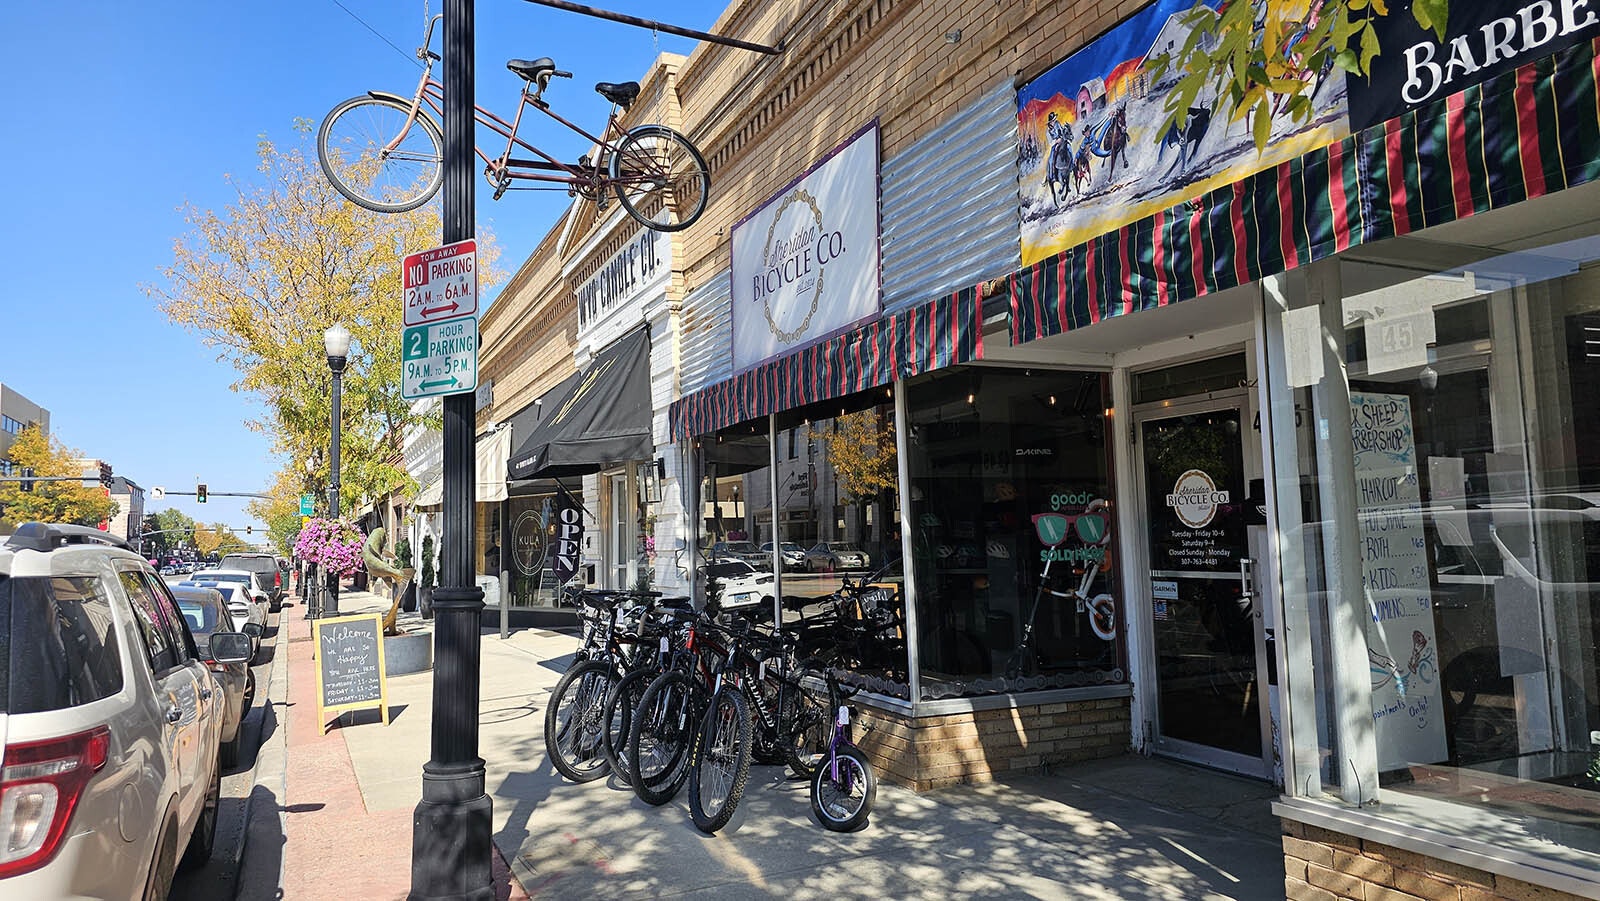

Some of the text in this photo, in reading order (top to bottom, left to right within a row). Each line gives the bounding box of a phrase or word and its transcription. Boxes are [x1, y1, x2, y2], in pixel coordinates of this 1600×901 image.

[1401, 0, 1600, 103] BARBE
[420, 246, 458, 262] TOW AWAY
[768, 226, 815, 268] Sheridan
[409, 257, 472, 286] NO PARKING
[600, 243, 636, 309] CANDLE
[640, 227, 660, 278] CO.
[753, 231, 846, 302] BICYCLE CO.
[410, 324, 463, 356] 2 HOUR
[430, 336, 472, 357] PARKING
[1385, 323, 1411, 349] 45
[1362, 401, 1398, 430] SHEEP
[1050, 491, 1093, 511] goodr
[1168, 492, 1229, 506] BICYCLE CO.
[556, 508, 580, 571] OPEN
[1171, 530, 1191, 538] Tuesday
[1195, 530, 1211, 538] Friday
[1181, 539, 1204, 548] Saturday
[1040, 548, 1073, 562] SOLD
[1186, 549, 1204, 557] Sunday
[1208, 549, 1231, 557] Monday
[1369, 567, 1397, 592] KIDS
[322, 625, 375, 644] Welcome
[337, 654, 368, 665] Happy
[327, 688, 349, 696] FRIDAY
